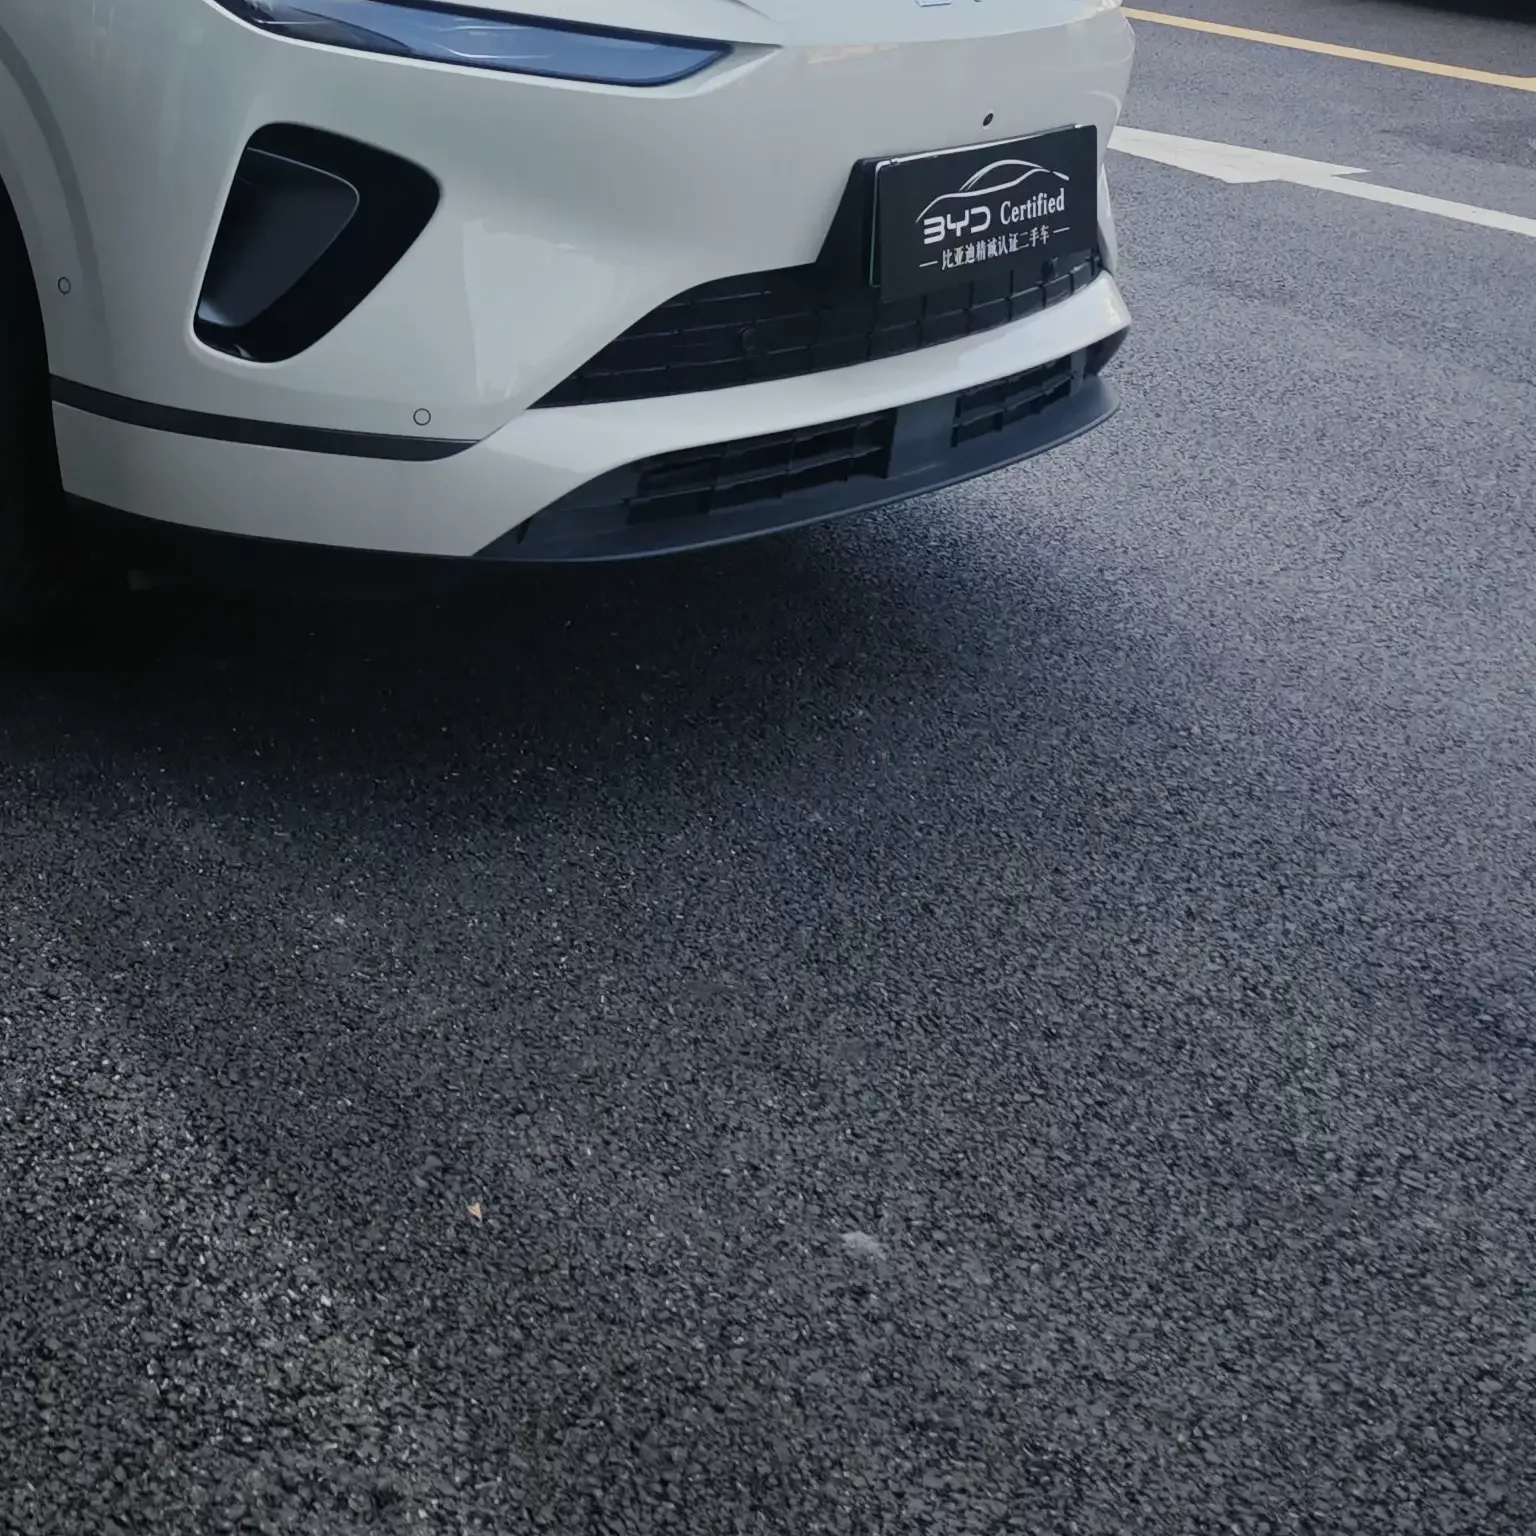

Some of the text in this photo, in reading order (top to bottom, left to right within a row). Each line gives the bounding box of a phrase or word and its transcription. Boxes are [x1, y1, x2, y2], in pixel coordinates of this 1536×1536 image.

[923, 187, 1065, 245] BYD Certified
[941, 224, 1049, 270] 比亚迪精诚认证二手车
